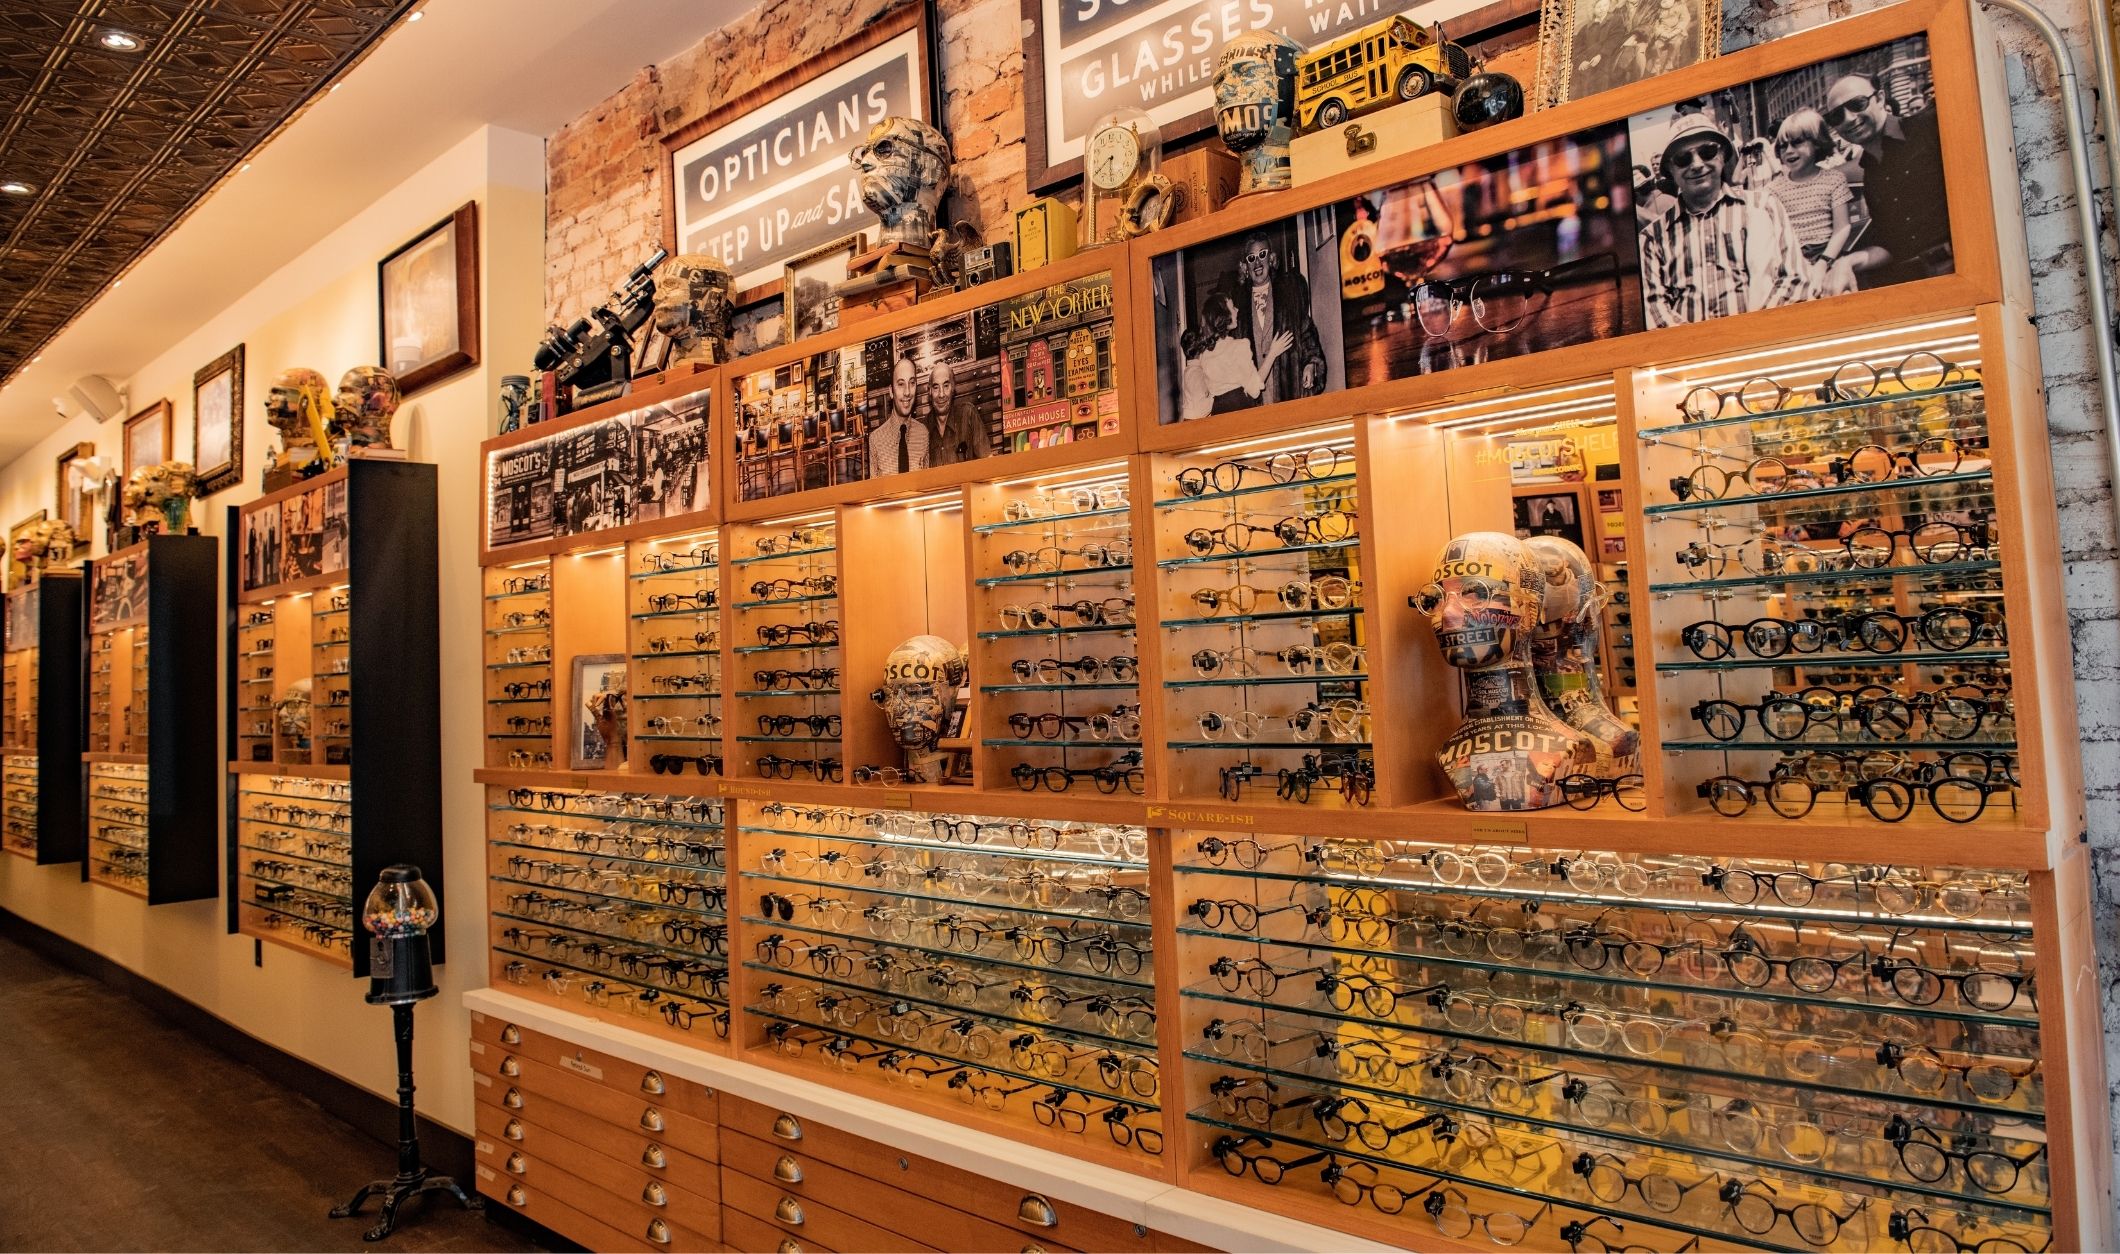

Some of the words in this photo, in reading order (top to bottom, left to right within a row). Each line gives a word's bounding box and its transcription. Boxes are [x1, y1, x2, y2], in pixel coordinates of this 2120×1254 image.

[1081, 0, 1274, 99] GLASSES
[1140, 57, 1212, 101] WHILE
[1312, 79, 1339, 94] SCHOOL
[1343, 70, 1359, 81] BUS
[700, 82, 887, 202] OPTICIANS
[759, 207, 789, 252] UP
[791, 196, 824, 230] and
[1048, 285, 1065, 298] THE
[1010, 302, 1046, 332] NEW
[1047, 284, 1112, 320] YORKER
[1073, 357, 1089, 367] EYES
[1039, 408, 1066, 422] HOUSE
[502, 451, 541, 478] MOSCOT'S
[1445, 629, 1491, 647] STREET
[1470, 725, 1492, 735] YEARS
[1494, 723, 1505, 731] AT
[1507, 722, 1526, 730] THIS
[1168, 809, 1254, 825] SQUARE-ISH
